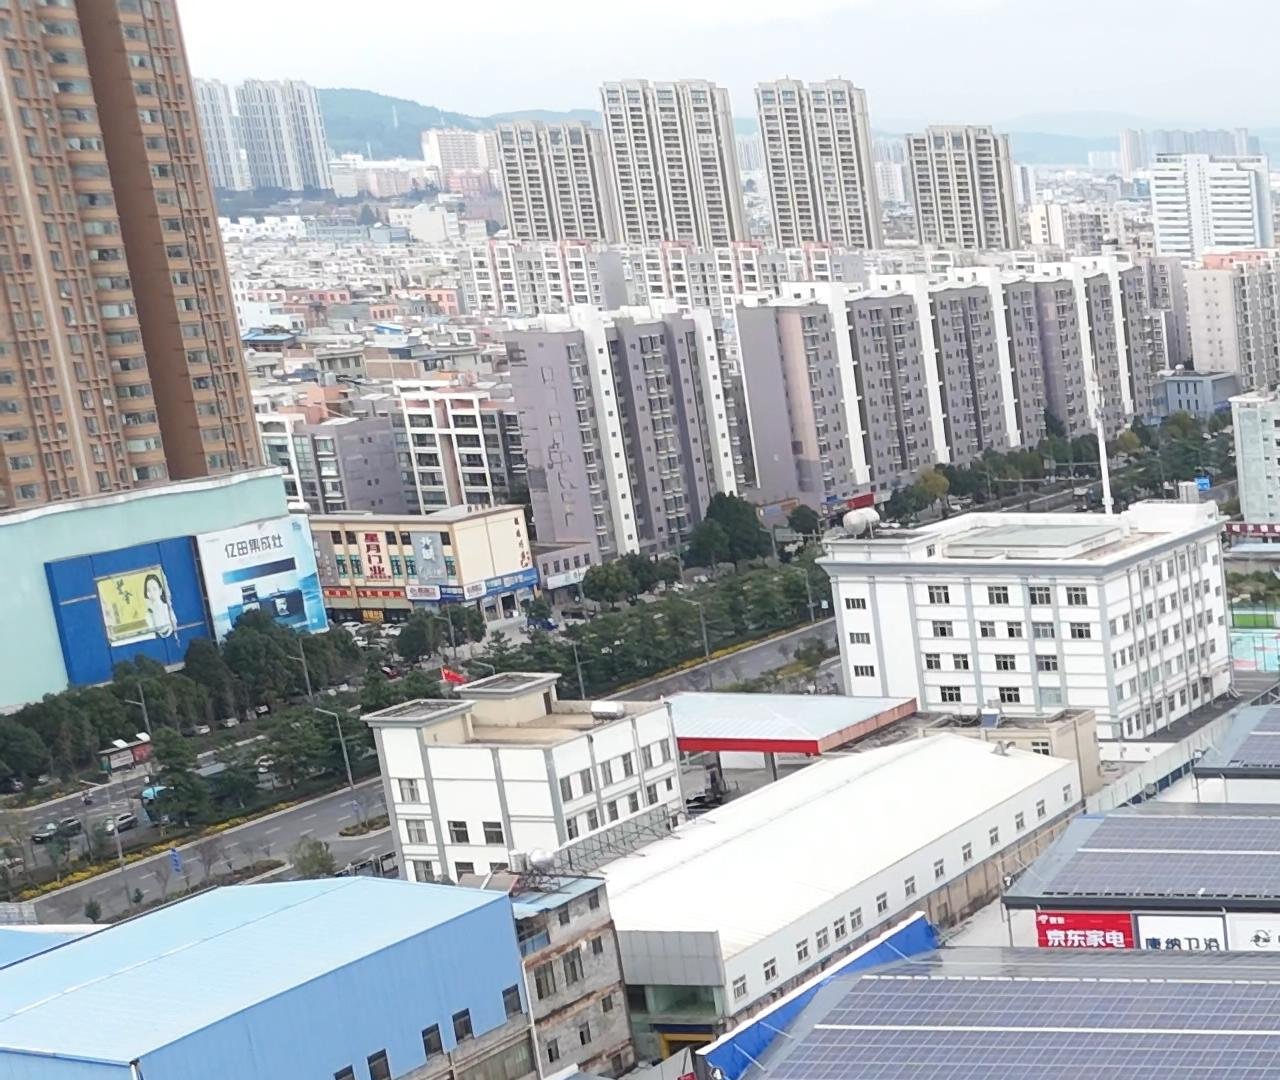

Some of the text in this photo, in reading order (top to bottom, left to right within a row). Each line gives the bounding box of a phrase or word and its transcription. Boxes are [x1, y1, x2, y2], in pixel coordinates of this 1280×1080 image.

[225, 533, 283, 559] 亿田集成灶
[1046, 930, 1125, 948] 京东家电
